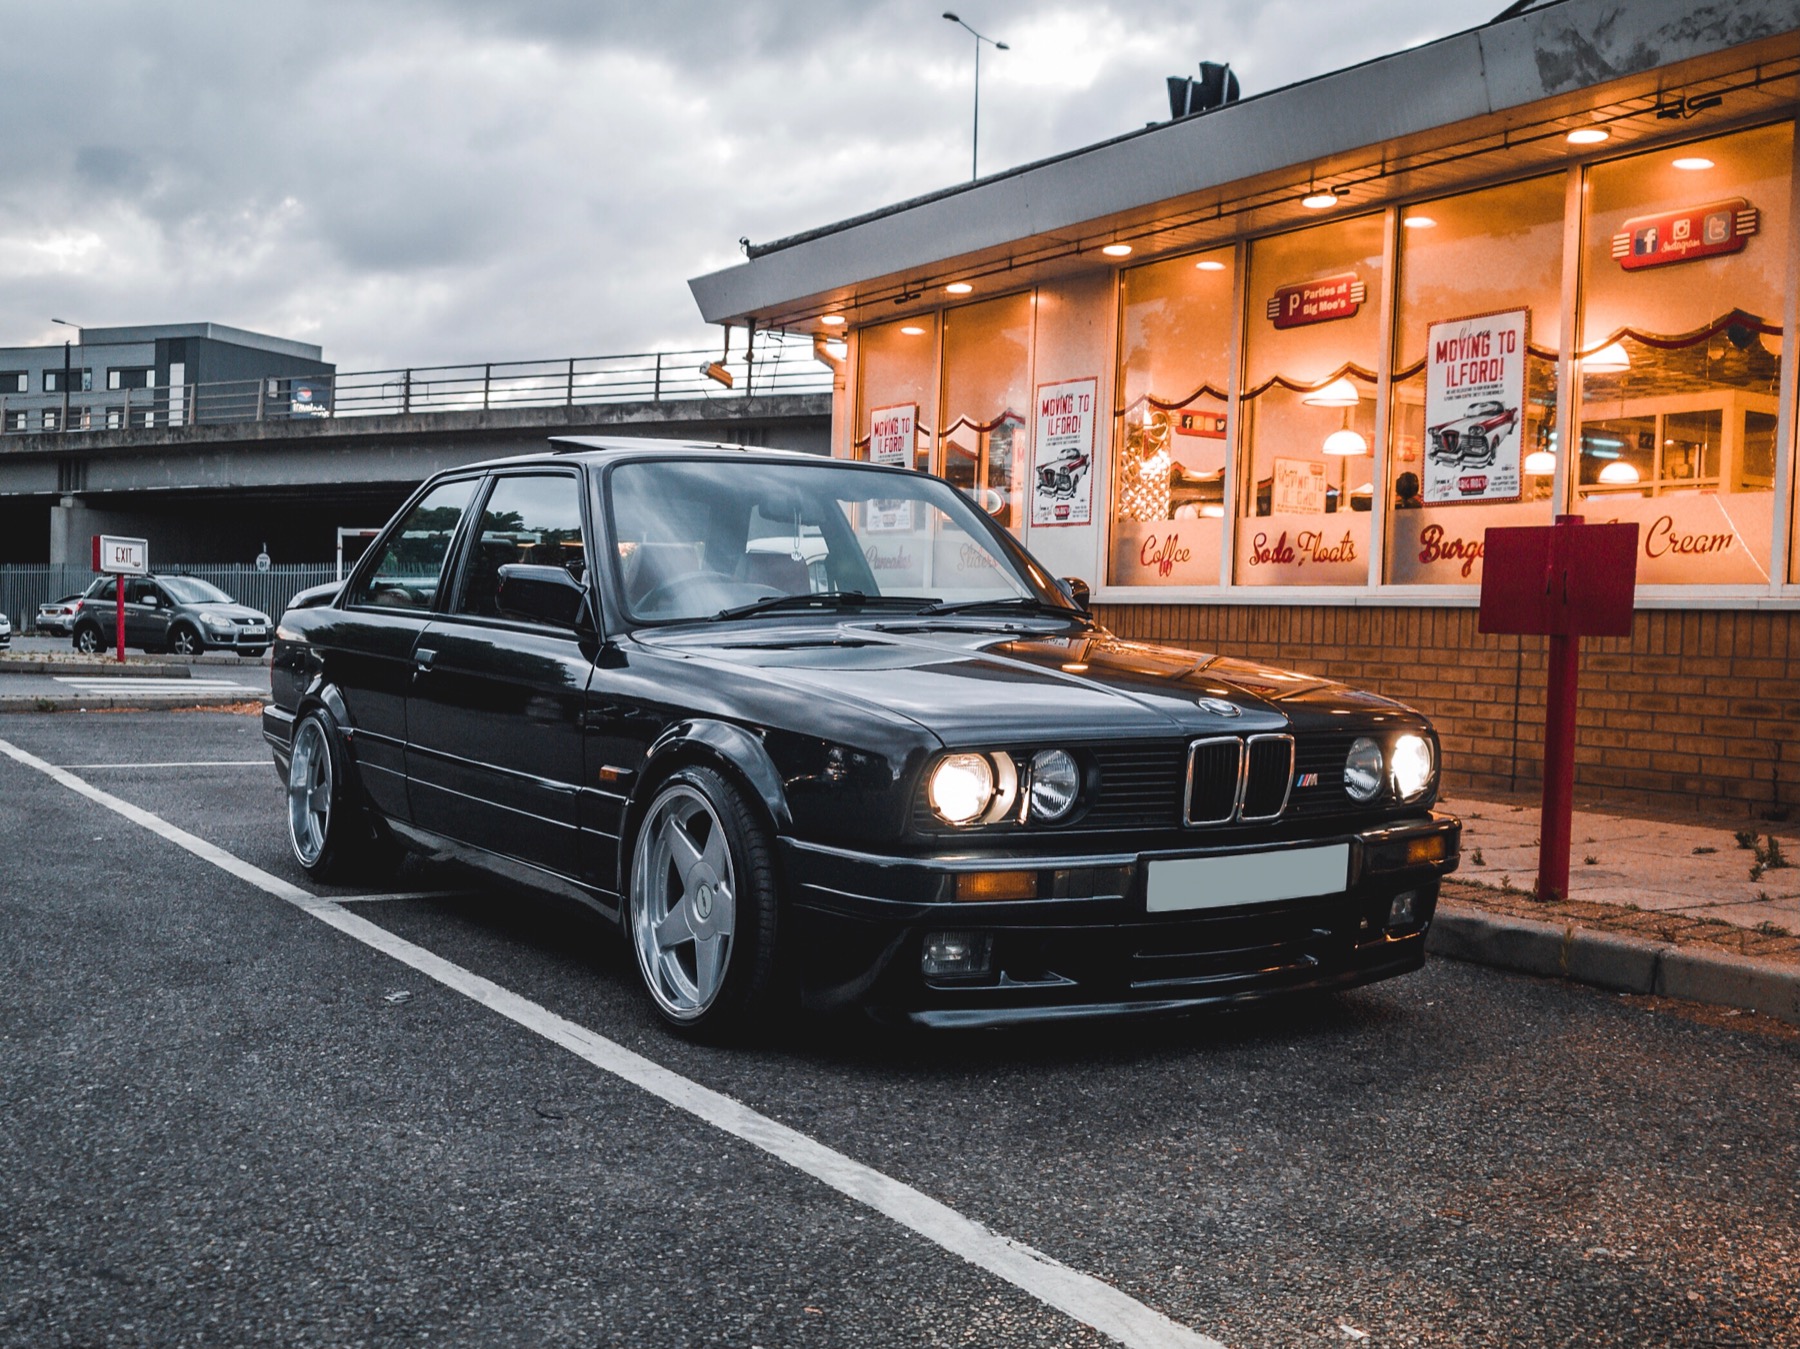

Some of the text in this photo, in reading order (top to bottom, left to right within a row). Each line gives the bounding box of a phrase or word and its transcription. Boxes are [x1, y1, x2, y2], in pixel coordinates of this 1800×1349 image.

[1661, 239, 1700, 255] Instagram
[1303, 283, 1347, 300] Parties at
[1303, 298, 1346, 316] Big Moe's
[1436, 330, 1516, 364] MOVING TO
[1446, 357, 1505, 388] ILFORD!
[1042, 396, 1073, 417] MOVING
[1078, 394, 1090, 413] TO
[874, 417, 910, 437] MOVING TO
[1048, 415, 1081, 436] ILFORD!
[878, 436, 905, 454] ILFORD!
[115, 546, 132, 563] EXIT
[1140, 533, 1191, 577] Coffee
[1249, 530, 1358, 567] Soda Floats
[1419, 515, 1734, 578] Burge Cream
